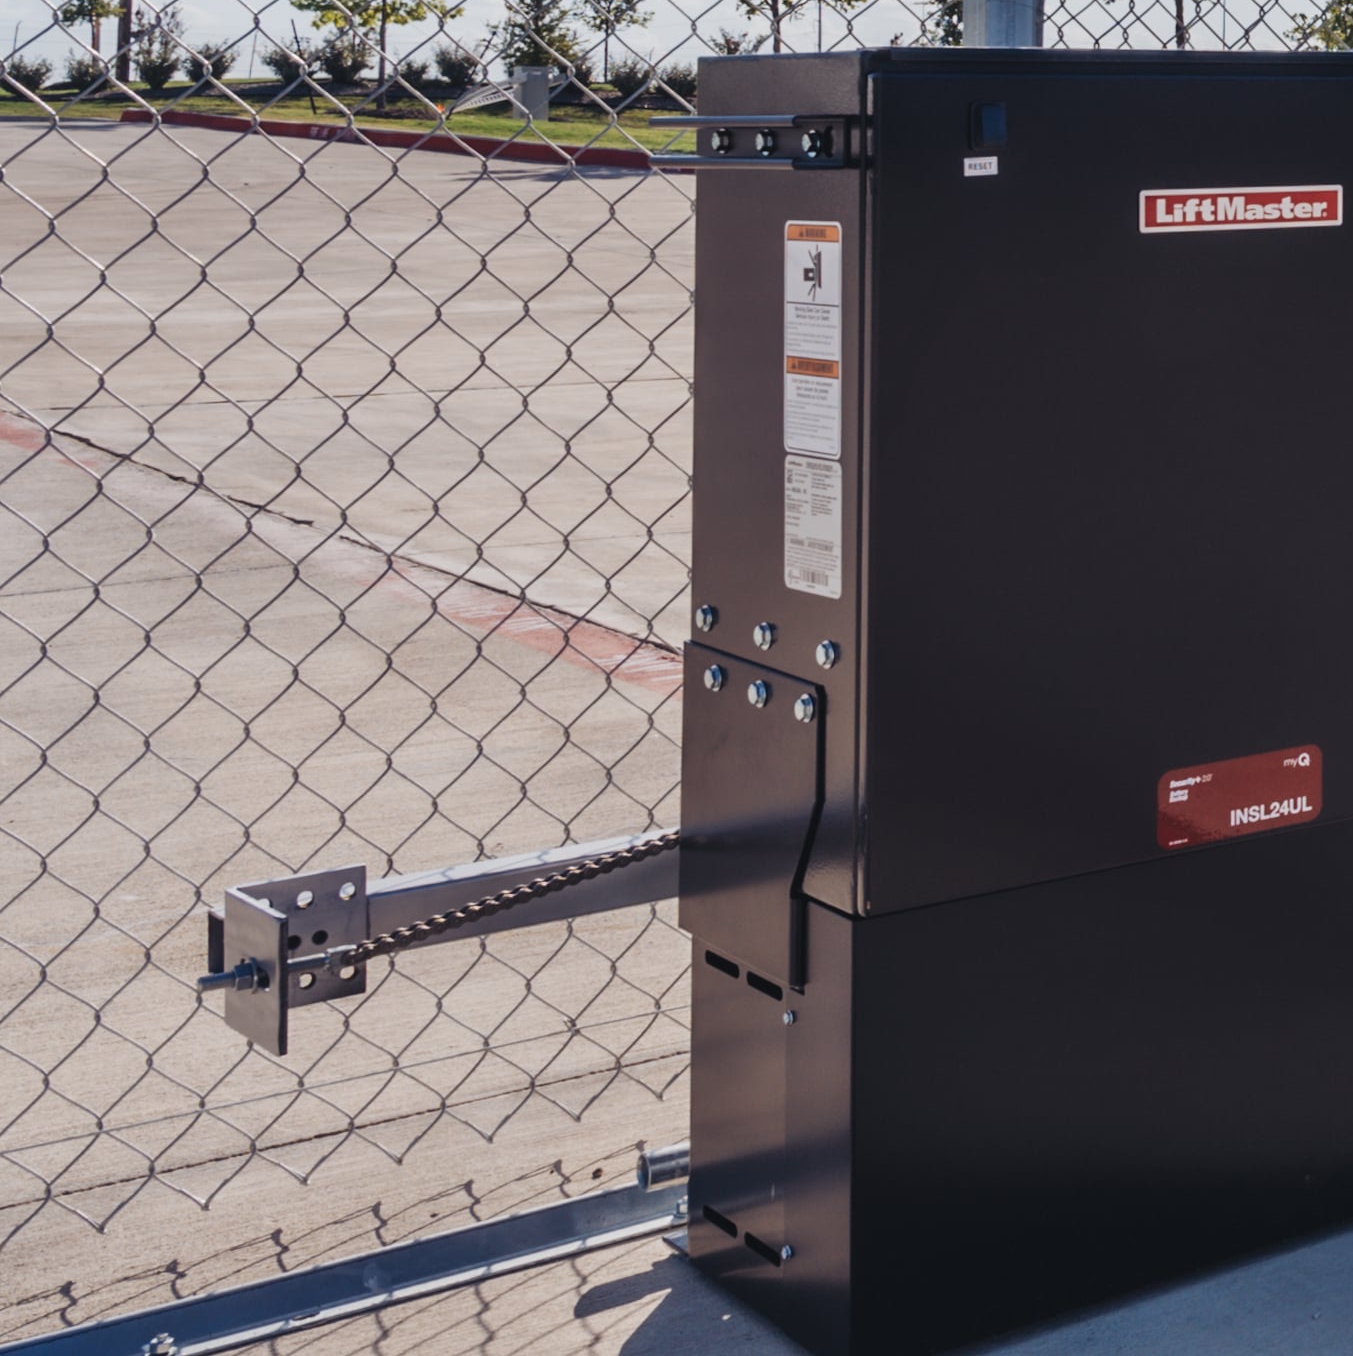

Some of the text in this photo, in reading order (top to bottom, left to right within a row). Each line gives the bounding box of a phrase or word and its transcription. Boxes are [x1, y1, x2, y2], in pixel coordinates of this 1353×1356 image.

[968, 161, 992, 171] RESET
[1156, 196, 1327, 223] LiftMaster
[1283, 752, 1311, 768] myQ
[1230, 795, 1313, 827] INSL24UL
